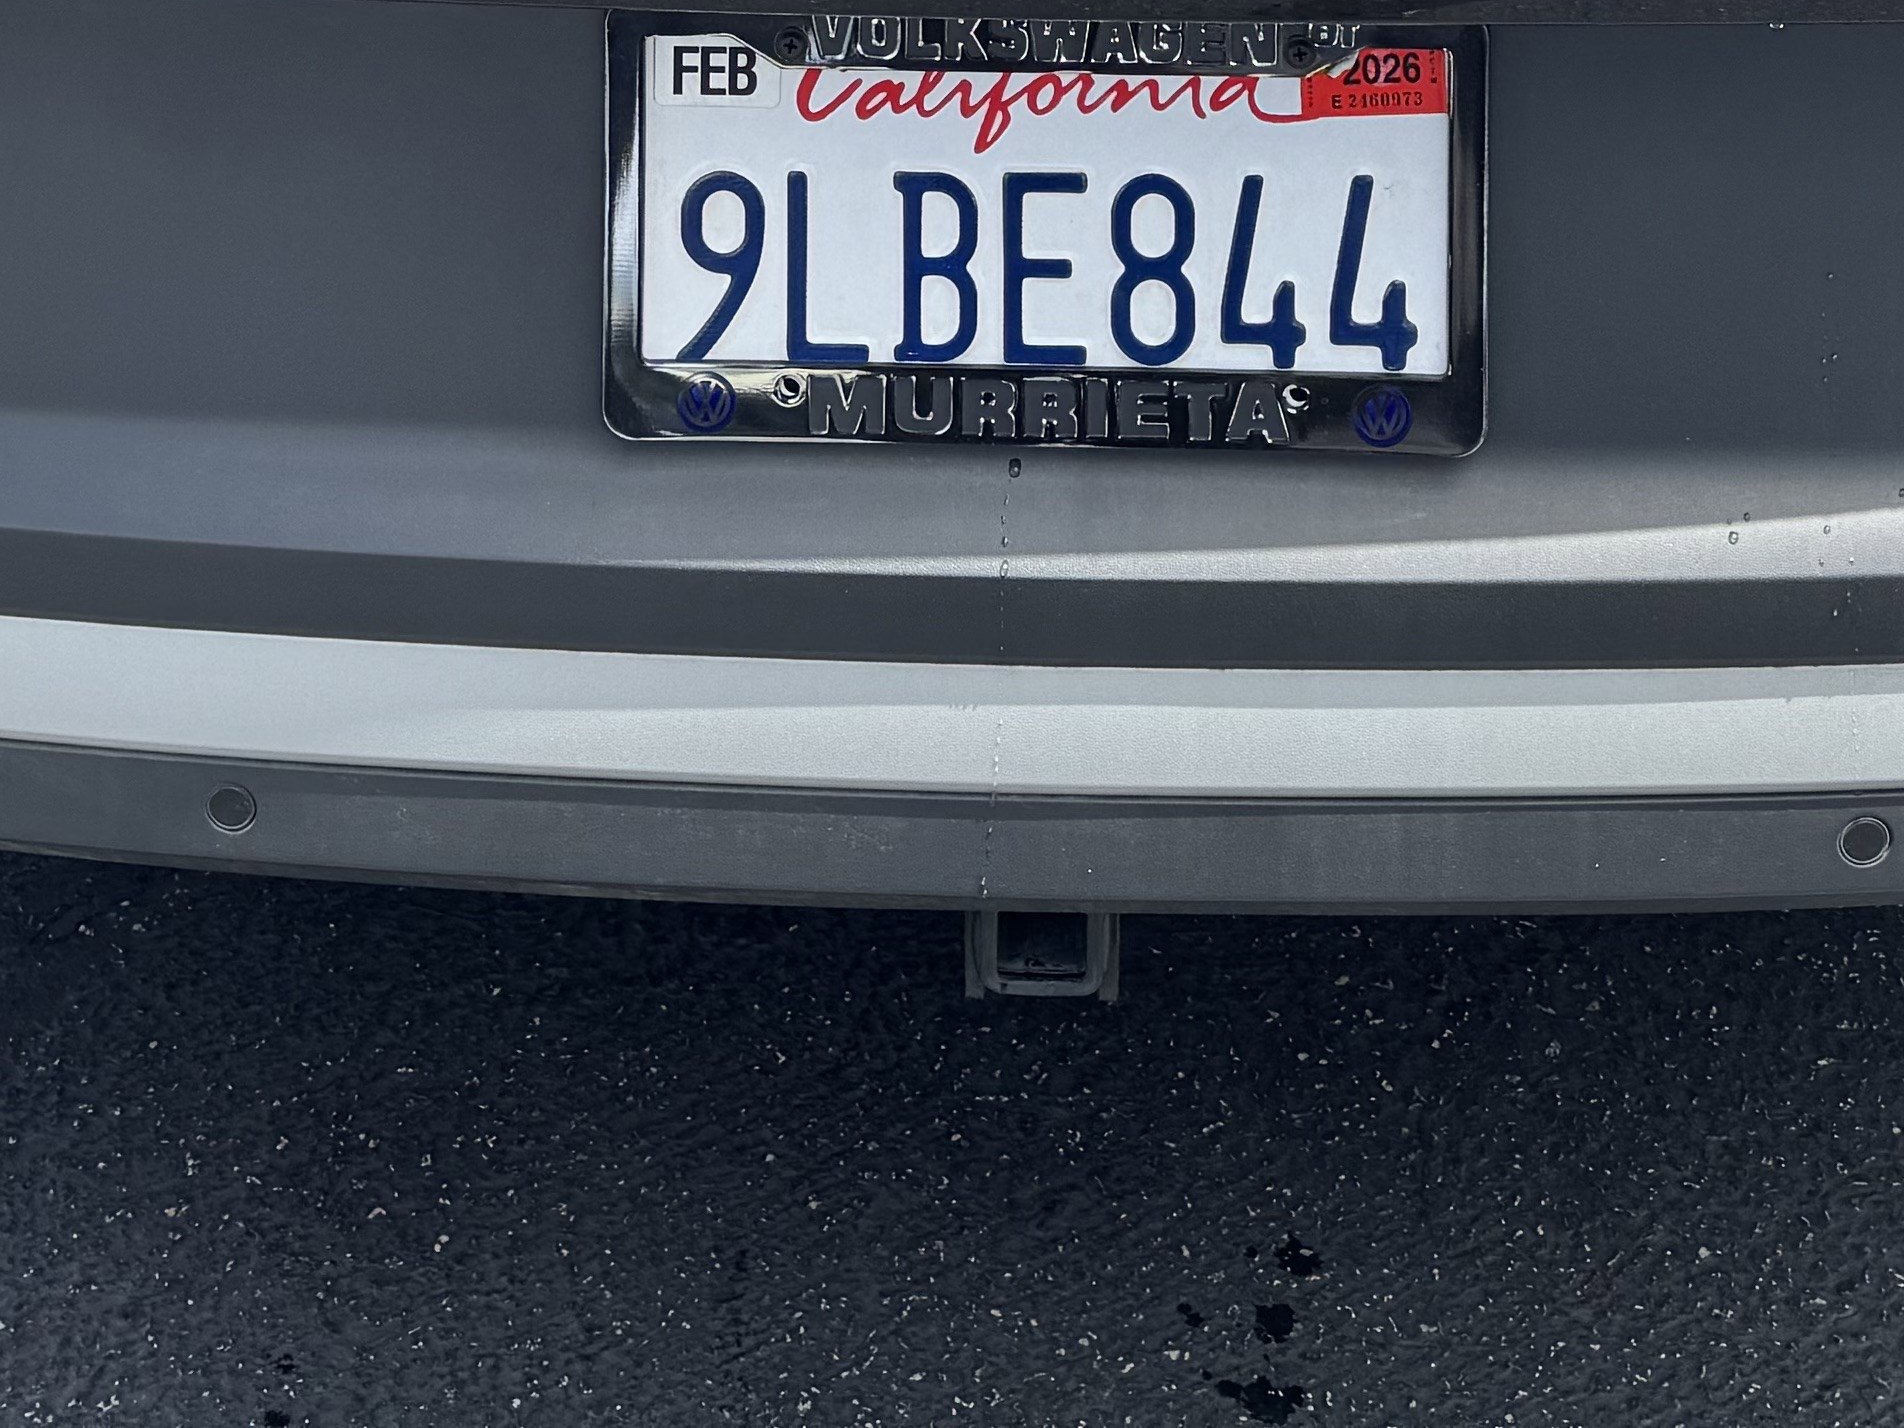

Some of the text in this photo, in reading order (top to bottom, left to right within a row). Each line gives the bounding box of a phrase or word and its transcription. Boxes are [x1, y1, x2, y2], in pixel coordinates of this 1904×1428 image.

[809, 15, 1280, 65] VOLKSWAGEN
[1343, 52, 1421, 85] 2026
[673, 46, 757, 95] FEB
[795, 68, 1303, 155] California
[675, 170, 1419, 372] 9LBE844
[806, 374, 1290, 443] MURRIETA
